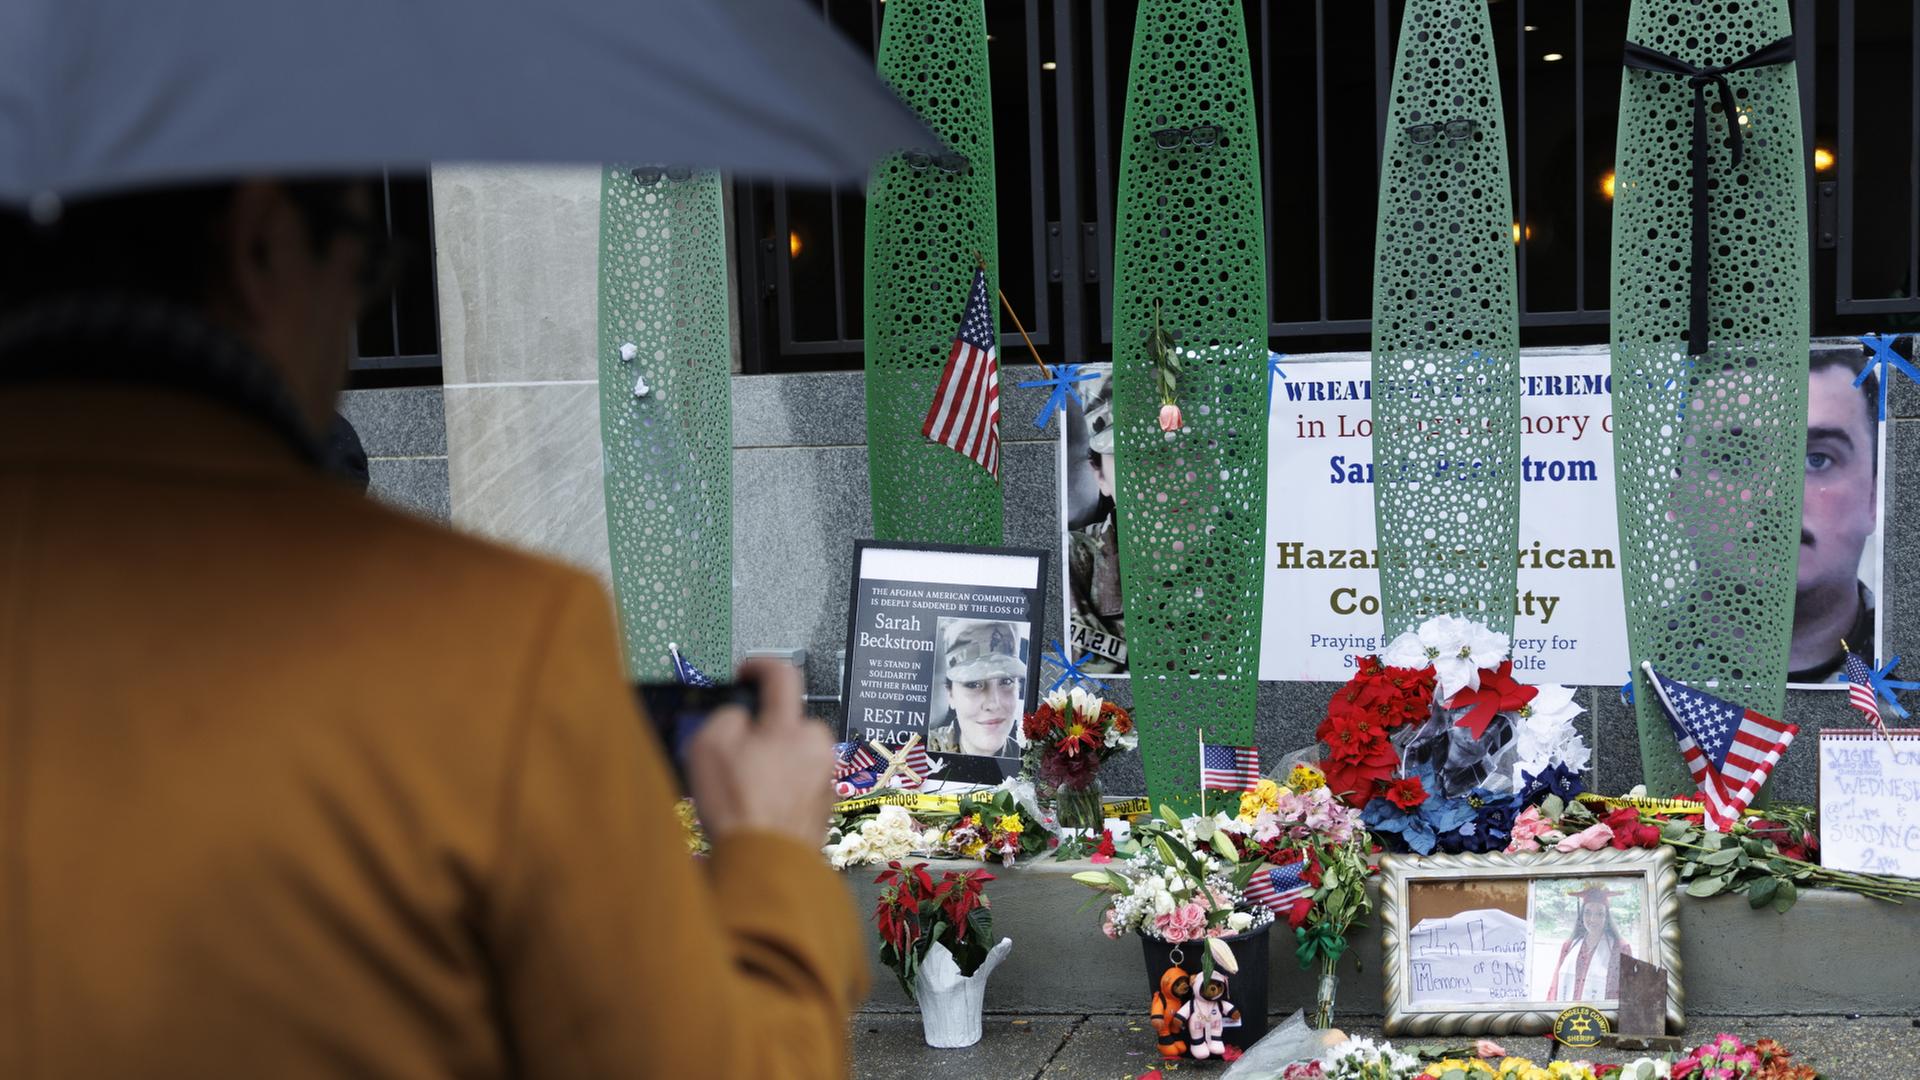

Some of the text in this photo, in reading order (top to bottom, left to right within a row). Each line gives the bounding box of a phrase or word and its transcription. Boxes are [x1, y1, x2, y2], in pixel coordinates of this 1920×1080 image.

[1285, 380, 1372, 401] WREAT
[1296, 414, 1326, 438] in
[1516, 541, 1615, 569] rican
[872, 587, 1027, 604] THE AFGHAN AMERICAN COMMUNITY
[871, 598, 1025, 615] IS DEEPLY SADDENED BY THE LOSS OF
[875, 613, 921, 631] Sarah
[860, 631, 934, 652] Beckstrom
[1310, 633, 1376, 651] Praying
[1552, 635, 1577, 650] for
[869, 659, 921, 670] WE STAND IN
[1513, 656, 1546, 670] olfe
[869, 670, 918, 680] SOLIDARITY
[860, 680, 929, 692] WITH HER FAMILY
[859, 690, 927, 703] AND LOVED ONES
[864, 707, 926, 727] REST IN
[1113, 798, 1149, 813] POLICE
[1413, 963, 1472, 993] Memory
[1567, 1035, 1595, 1043] SHERIFF
